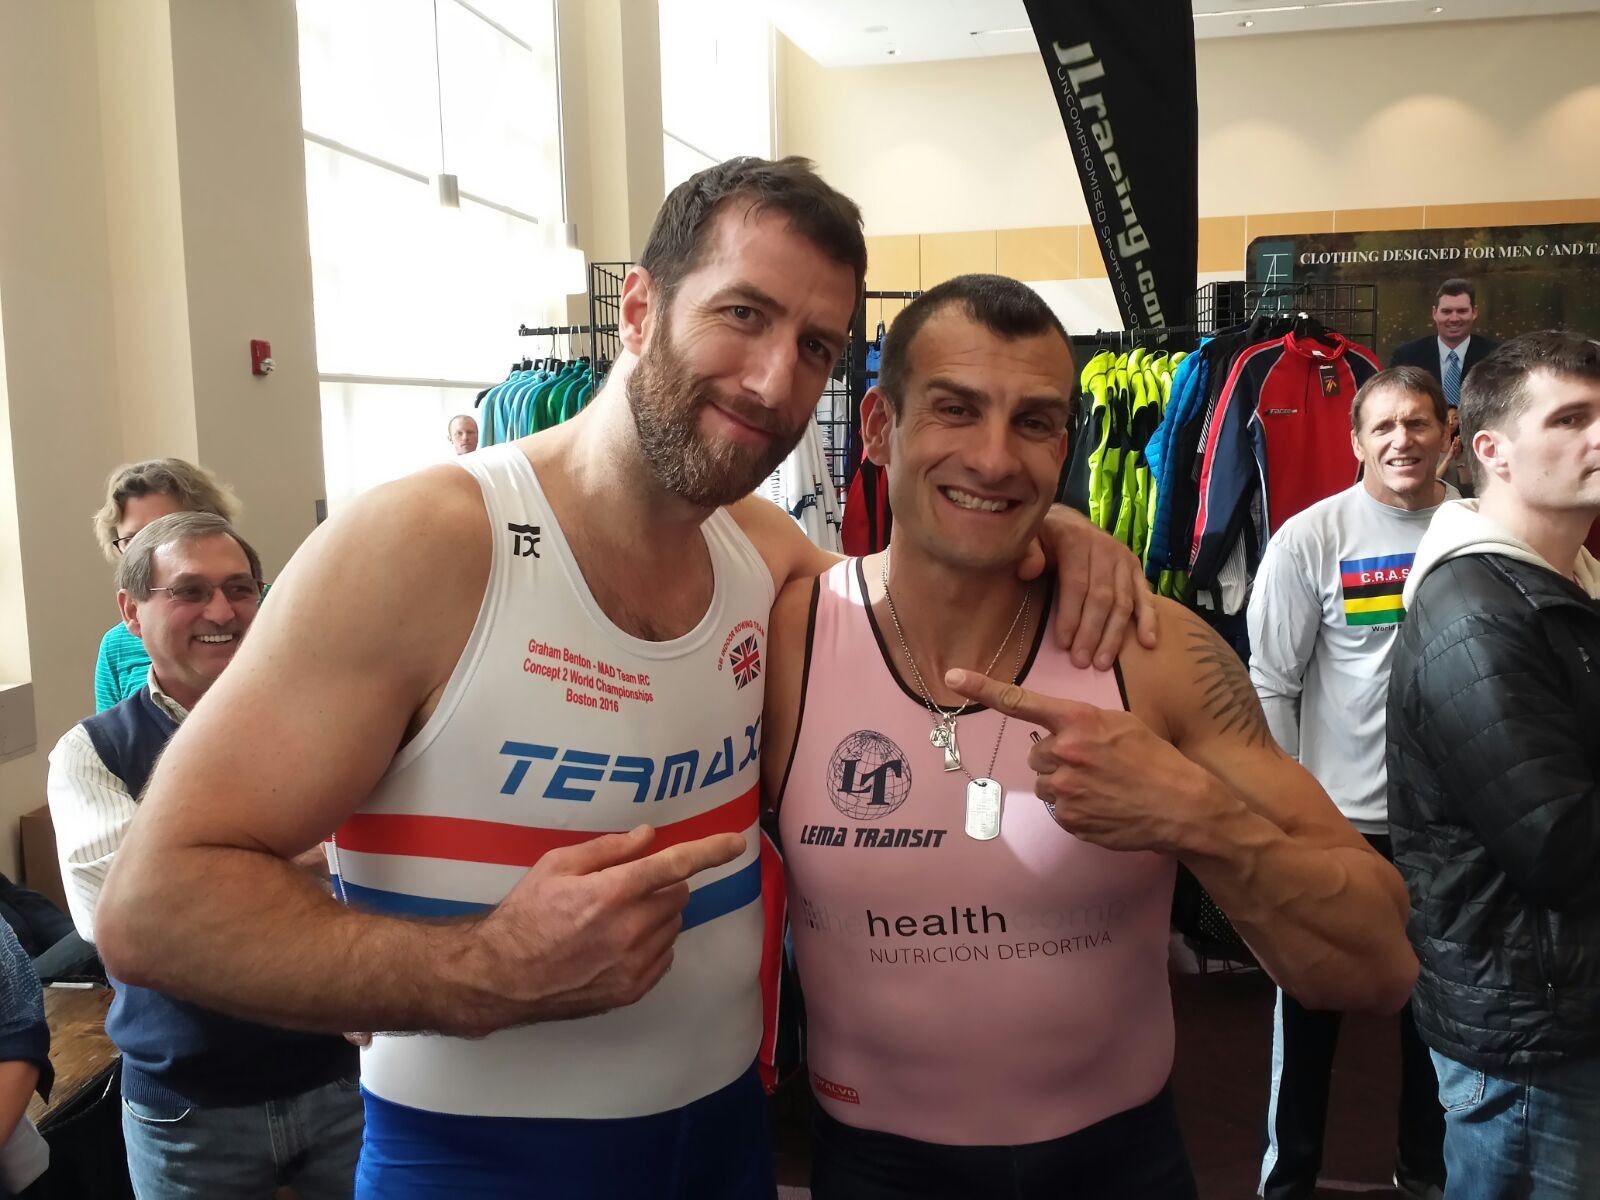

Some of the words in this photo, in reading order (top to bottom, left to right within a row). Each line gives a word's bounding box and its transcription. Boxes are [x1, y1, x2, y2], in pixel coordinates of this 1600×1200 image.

[1057, 66, 1107, 223] UNCOMPROMISED
[1300, 250, 1379, 265] CLOTHING
[1383, 247, 1461, 262] DESIGNED
[1464, 246, 1496, 259] FOR
[1498, 244, 1533, 258] MEN
[1550, 243, 1584, 256] AND
[523, 657, 561, 682] Concept
[562, 667, 568, 681] 2
[569, 668, 594, 689] World
[595, 677, 654, 704] Championships
[528, 638, 561, 660] Graham
[563, 647, 592, 670] Benton
[597, 660, 616, 678] MAD
[616, 668, 637, 685] Team
[637, 674, 650, 686] IRC
[566, 687, 598, 708] Boston
[599, 696, 619, 713] 2016
[499, 714, 761, 803] TERMAX
[800, 824, 848, 847] LEMA
[853, 828, 948, 848] TRANSIT
[869, 943, 989, 965] NUTRICIÓN
[997, 930, 1112, 960] DEPORTIVA
